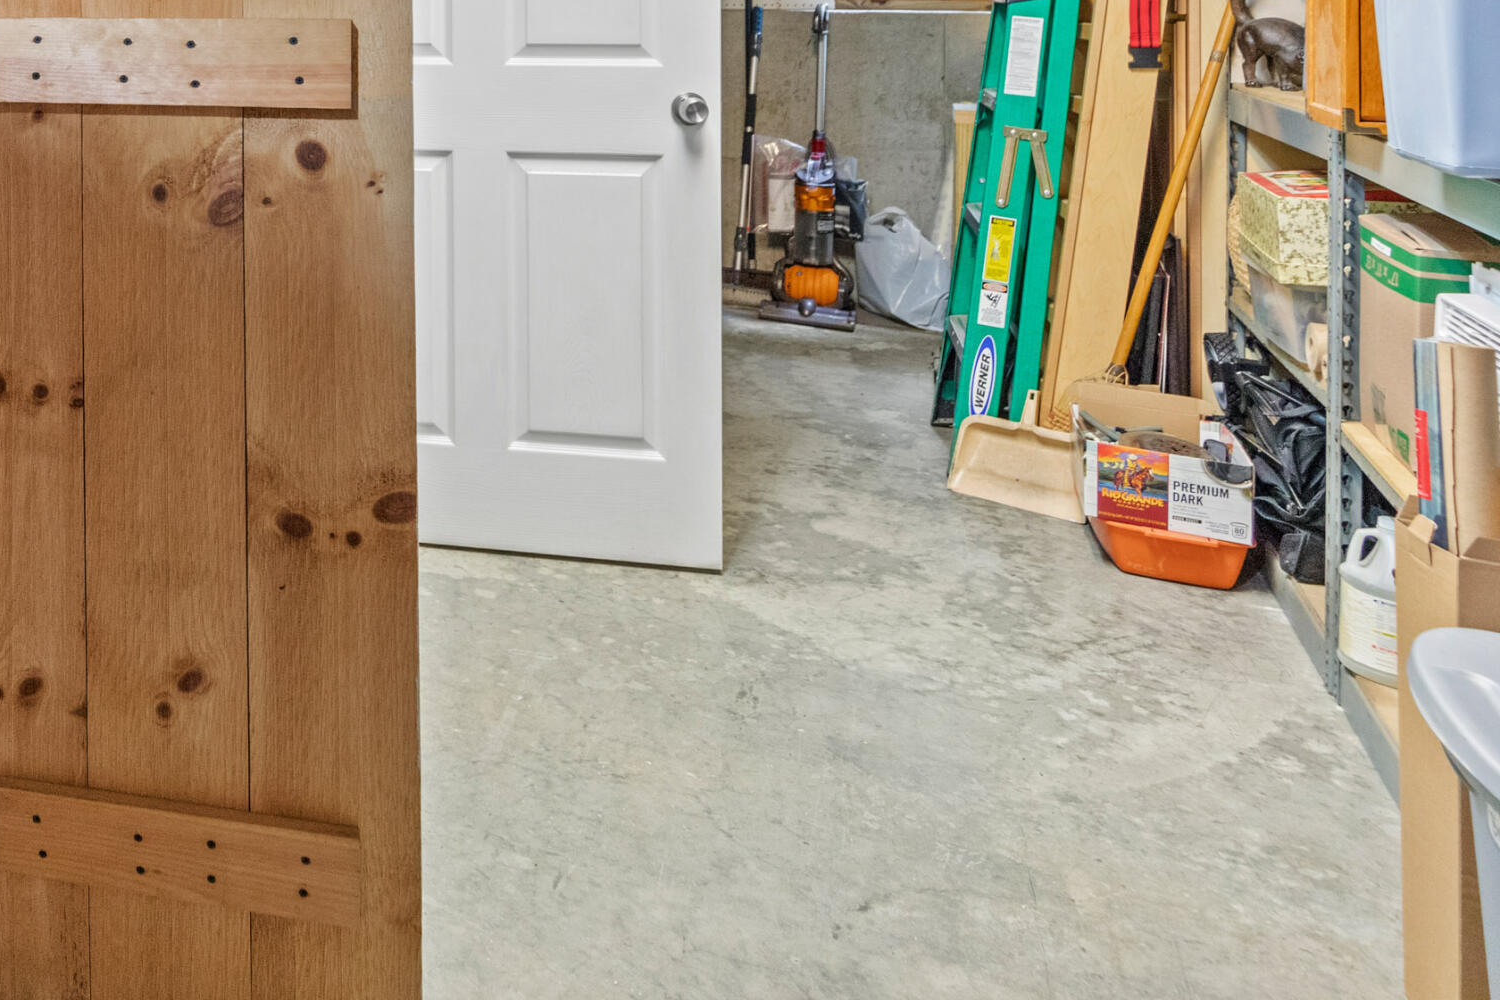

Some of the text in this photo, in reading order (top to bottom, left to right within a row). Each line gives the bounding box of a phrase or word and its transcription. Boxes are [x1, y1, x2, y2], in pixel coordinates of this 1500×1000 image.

[973, 351, 993, 411] WERNER
[1120, 490, 1166, 509] GRANDE
[1172, 480, 1230, 500] PREMIUM
[1172, 491, 1205, 507] DARK
[1234, 527, 1246, 536] 80
